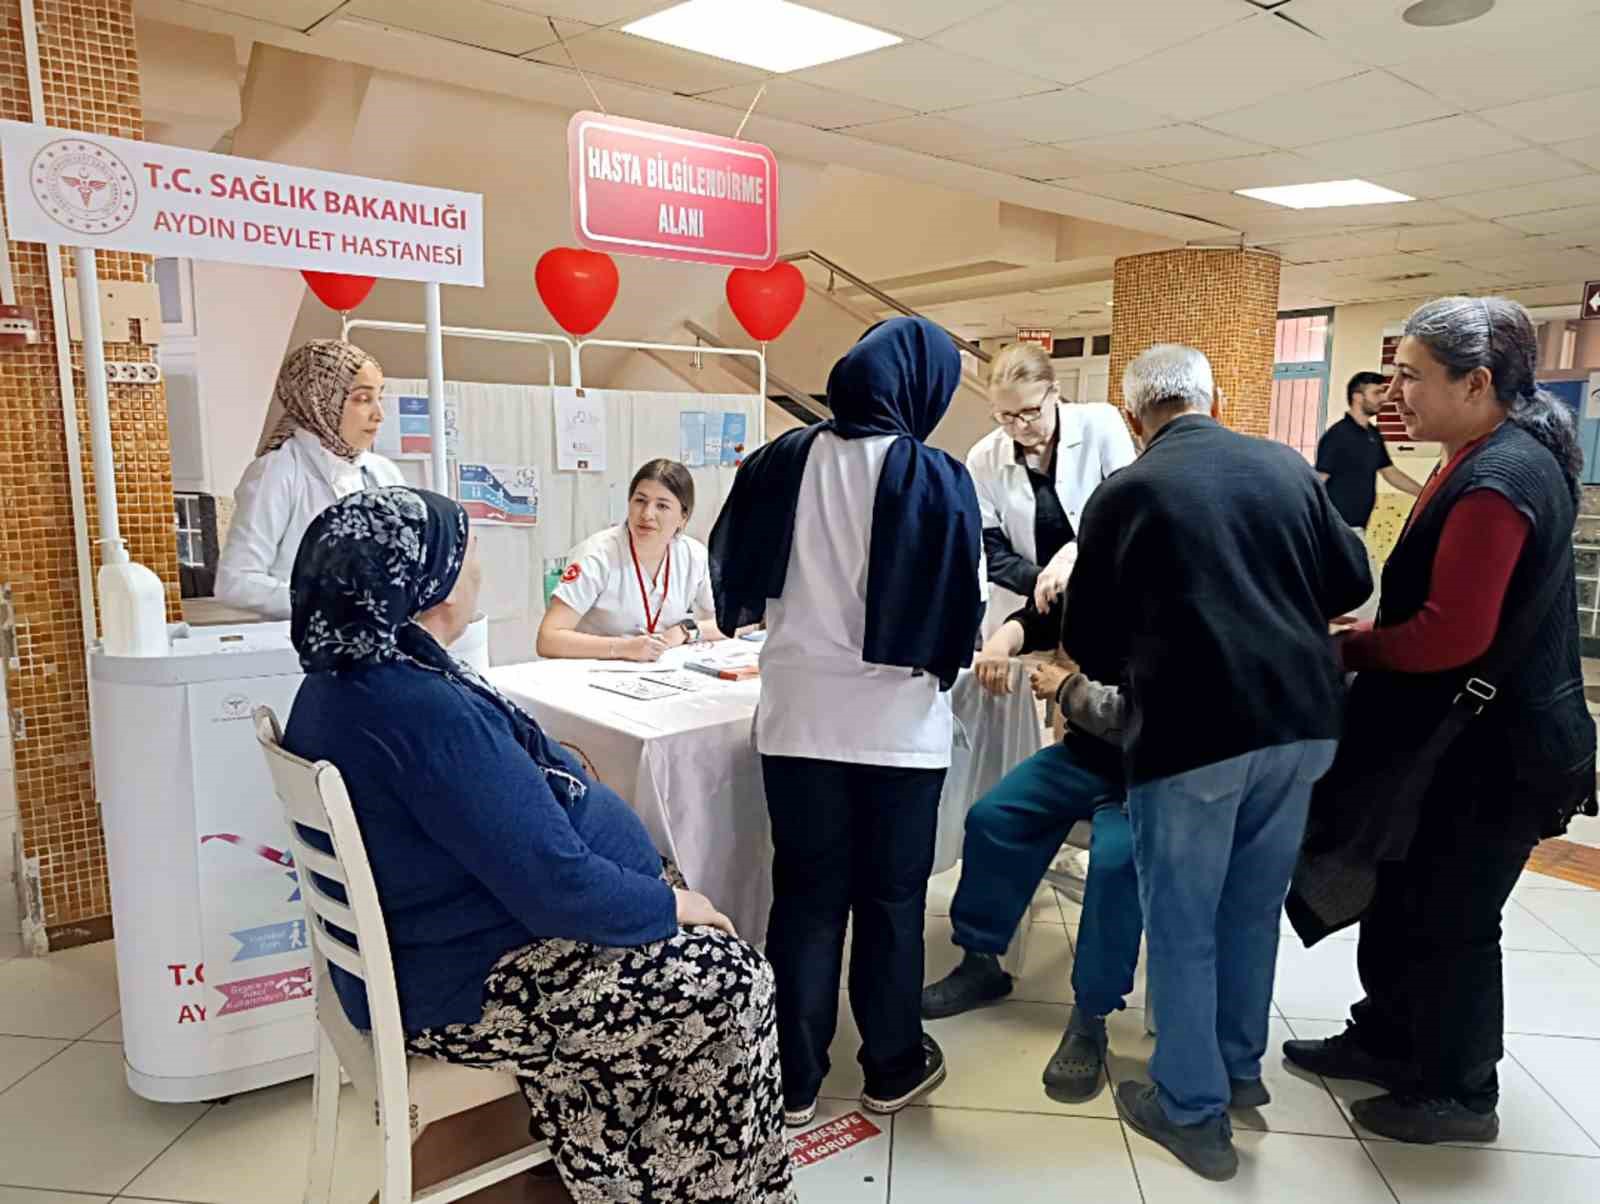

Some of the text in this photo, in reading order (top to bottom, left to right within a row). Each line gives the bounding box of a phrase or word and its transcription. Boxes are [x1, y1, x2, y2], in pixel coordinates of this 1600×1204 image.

[143, 162, 202, 195] T.C.
[210, 173, 317, 211] SAĞLIK
[324, 190, 467, 231] BAKANLIĞI
[588, 146, 764, 205] HASTA BİLGİLENDİRME
[153, 210, 463, 267] AYDIN DEVLET HASTANESİ
[658, 203, 705, 238] ALANI
[806, 1115, 862, 1143] MESAFE
[806, 1133, 857, 1159] KORUR
